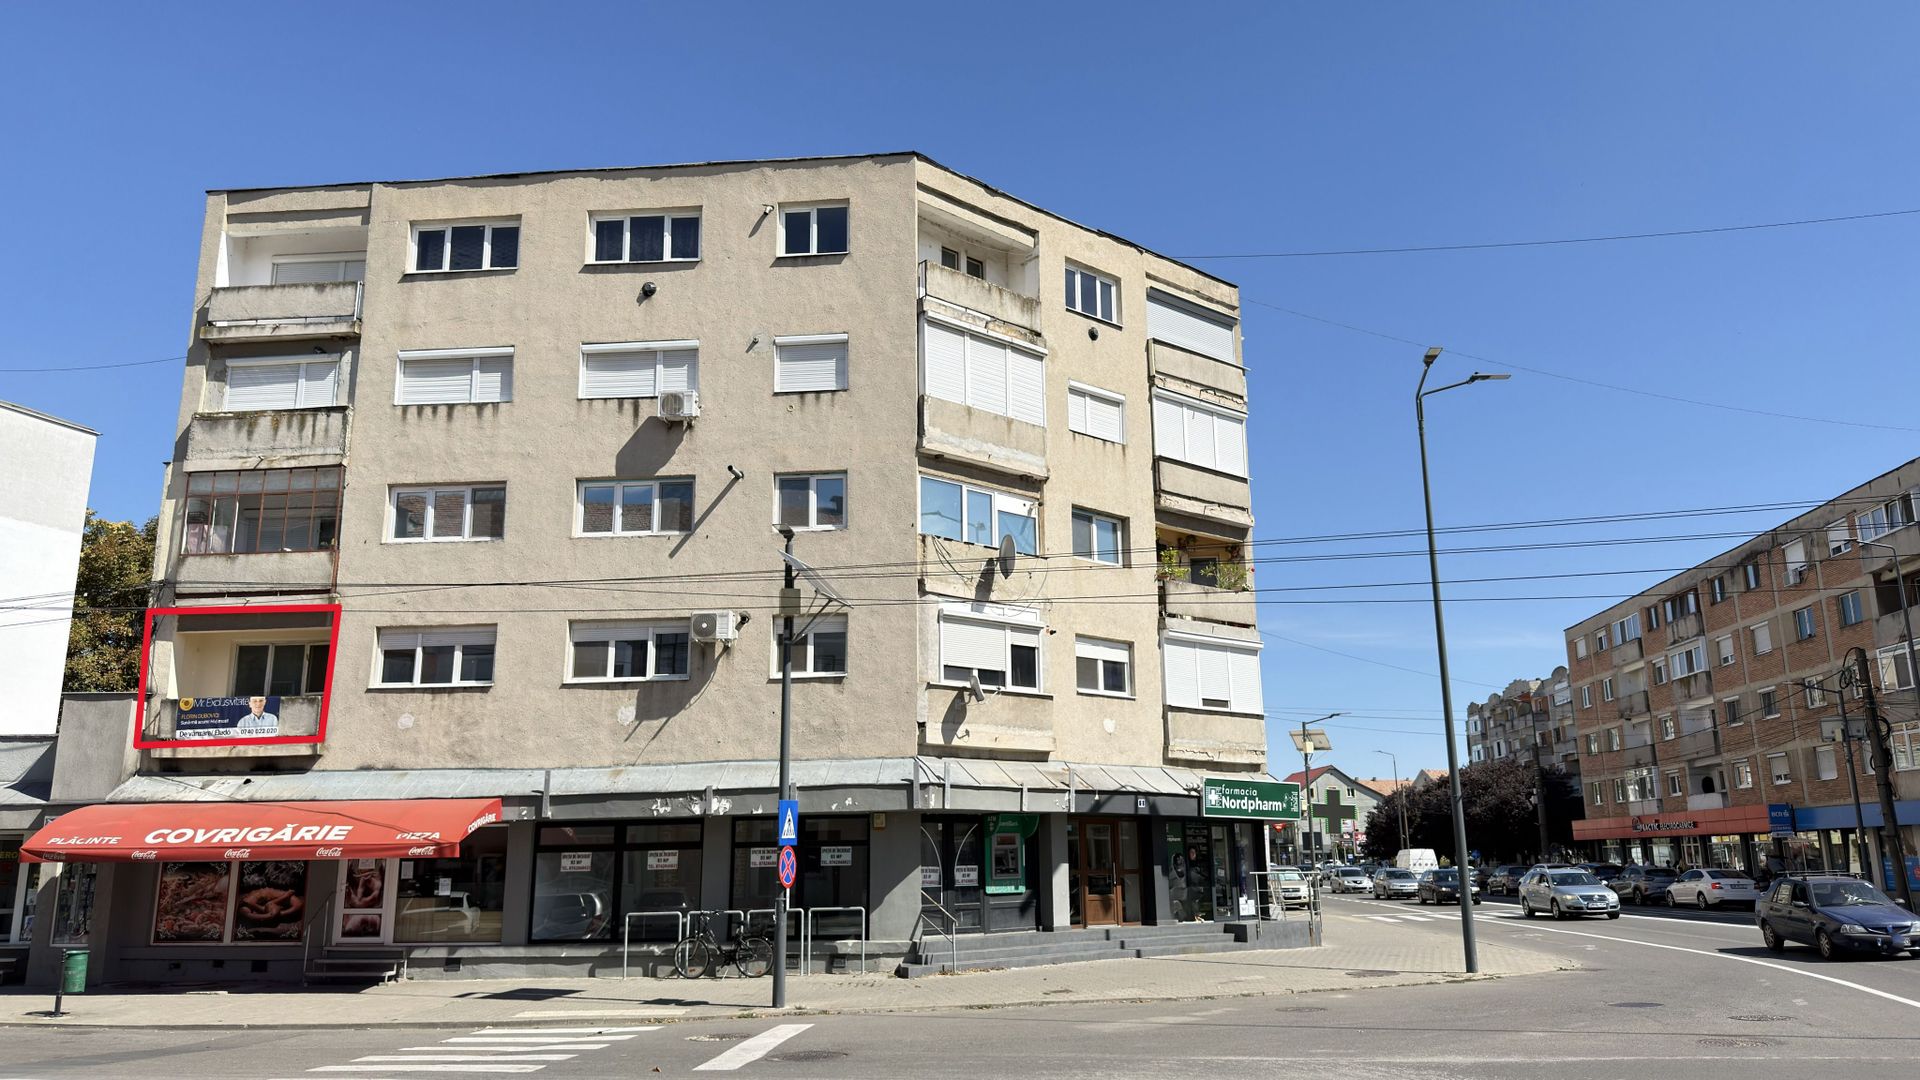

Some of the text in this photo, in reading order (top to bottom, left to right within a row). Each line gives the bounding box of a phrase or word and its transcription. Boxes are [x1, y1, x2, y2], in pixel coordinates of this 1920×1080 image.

[179, 730, 188, 738] De
[1221, 784, 1257, 796] farmacia
[1222, 796, 1282, 813] Nordpharm
[467, 812, 497, 834] COVRIGĂRIE
[144, 823, 354, 844] COVRIGĂRIE
[395, 831, 441, 841] PIZZA
[47, 835, 123, 845] PLĂCINTE
[131, 850, 158, 860] Coca-Cola
[224, 848, 251, 859] Coca-Cola
[316, 847, 343, 857] Coca-Cola
[408, 845, 437, 856] Coca-Cola
